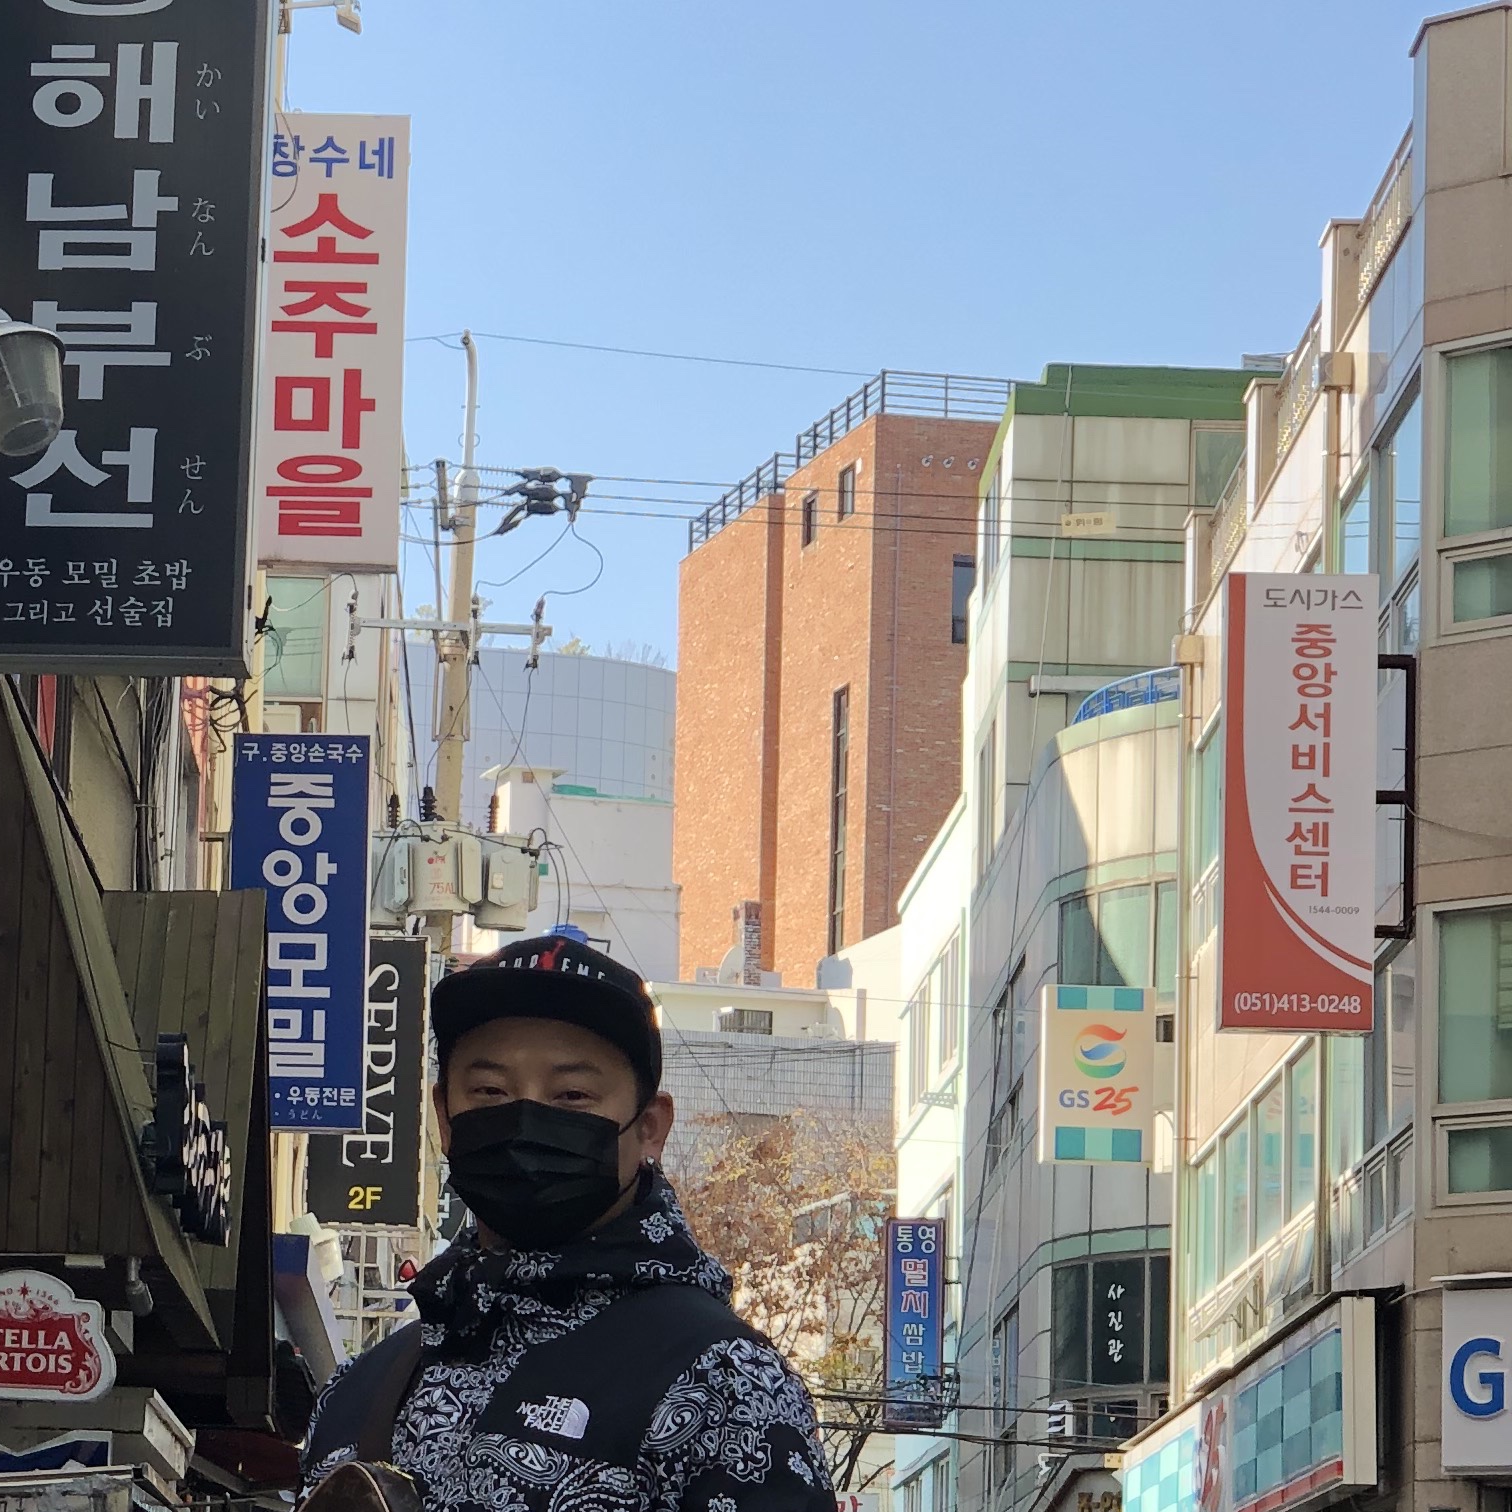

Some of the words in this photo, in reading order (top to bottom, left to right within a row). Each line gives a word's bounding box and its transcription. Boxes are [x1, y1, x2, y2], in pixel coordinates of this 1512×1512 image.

[272, 134, 395, 179] 창수네
[9, 0, 179, 528] 해남부선
[266, 193, 380, 538] 소주마을
[62, 557, 119, 589] 모밀
[132, 558, 192, 591] 초밥
[3, 599, 76, 625] 그리고
[87, 595, 174, 628] 선술집
[1263, 588, 1364, 612] 도시가스
[1285, 623, 1338, 898] 중앙서비스센터
[1307, 904, 1361, 916] 1544-0009
[261, 772, 338, 1079] 중앙모밀
[1233, 992, 1362, 1015] (051)413-0248
[286, 1086, 356, 1106] 우동전문
[347, 1186, 383, 1211] 2F
[896, 1225, 937, 1254] 통영
[1107, 1283, 1126, 1363] 사진관
[515, 1401, 568, 1425] NORTH
[545, 1395, 572, 1411] THE
[523, 1415, 563, 1434] FACE
